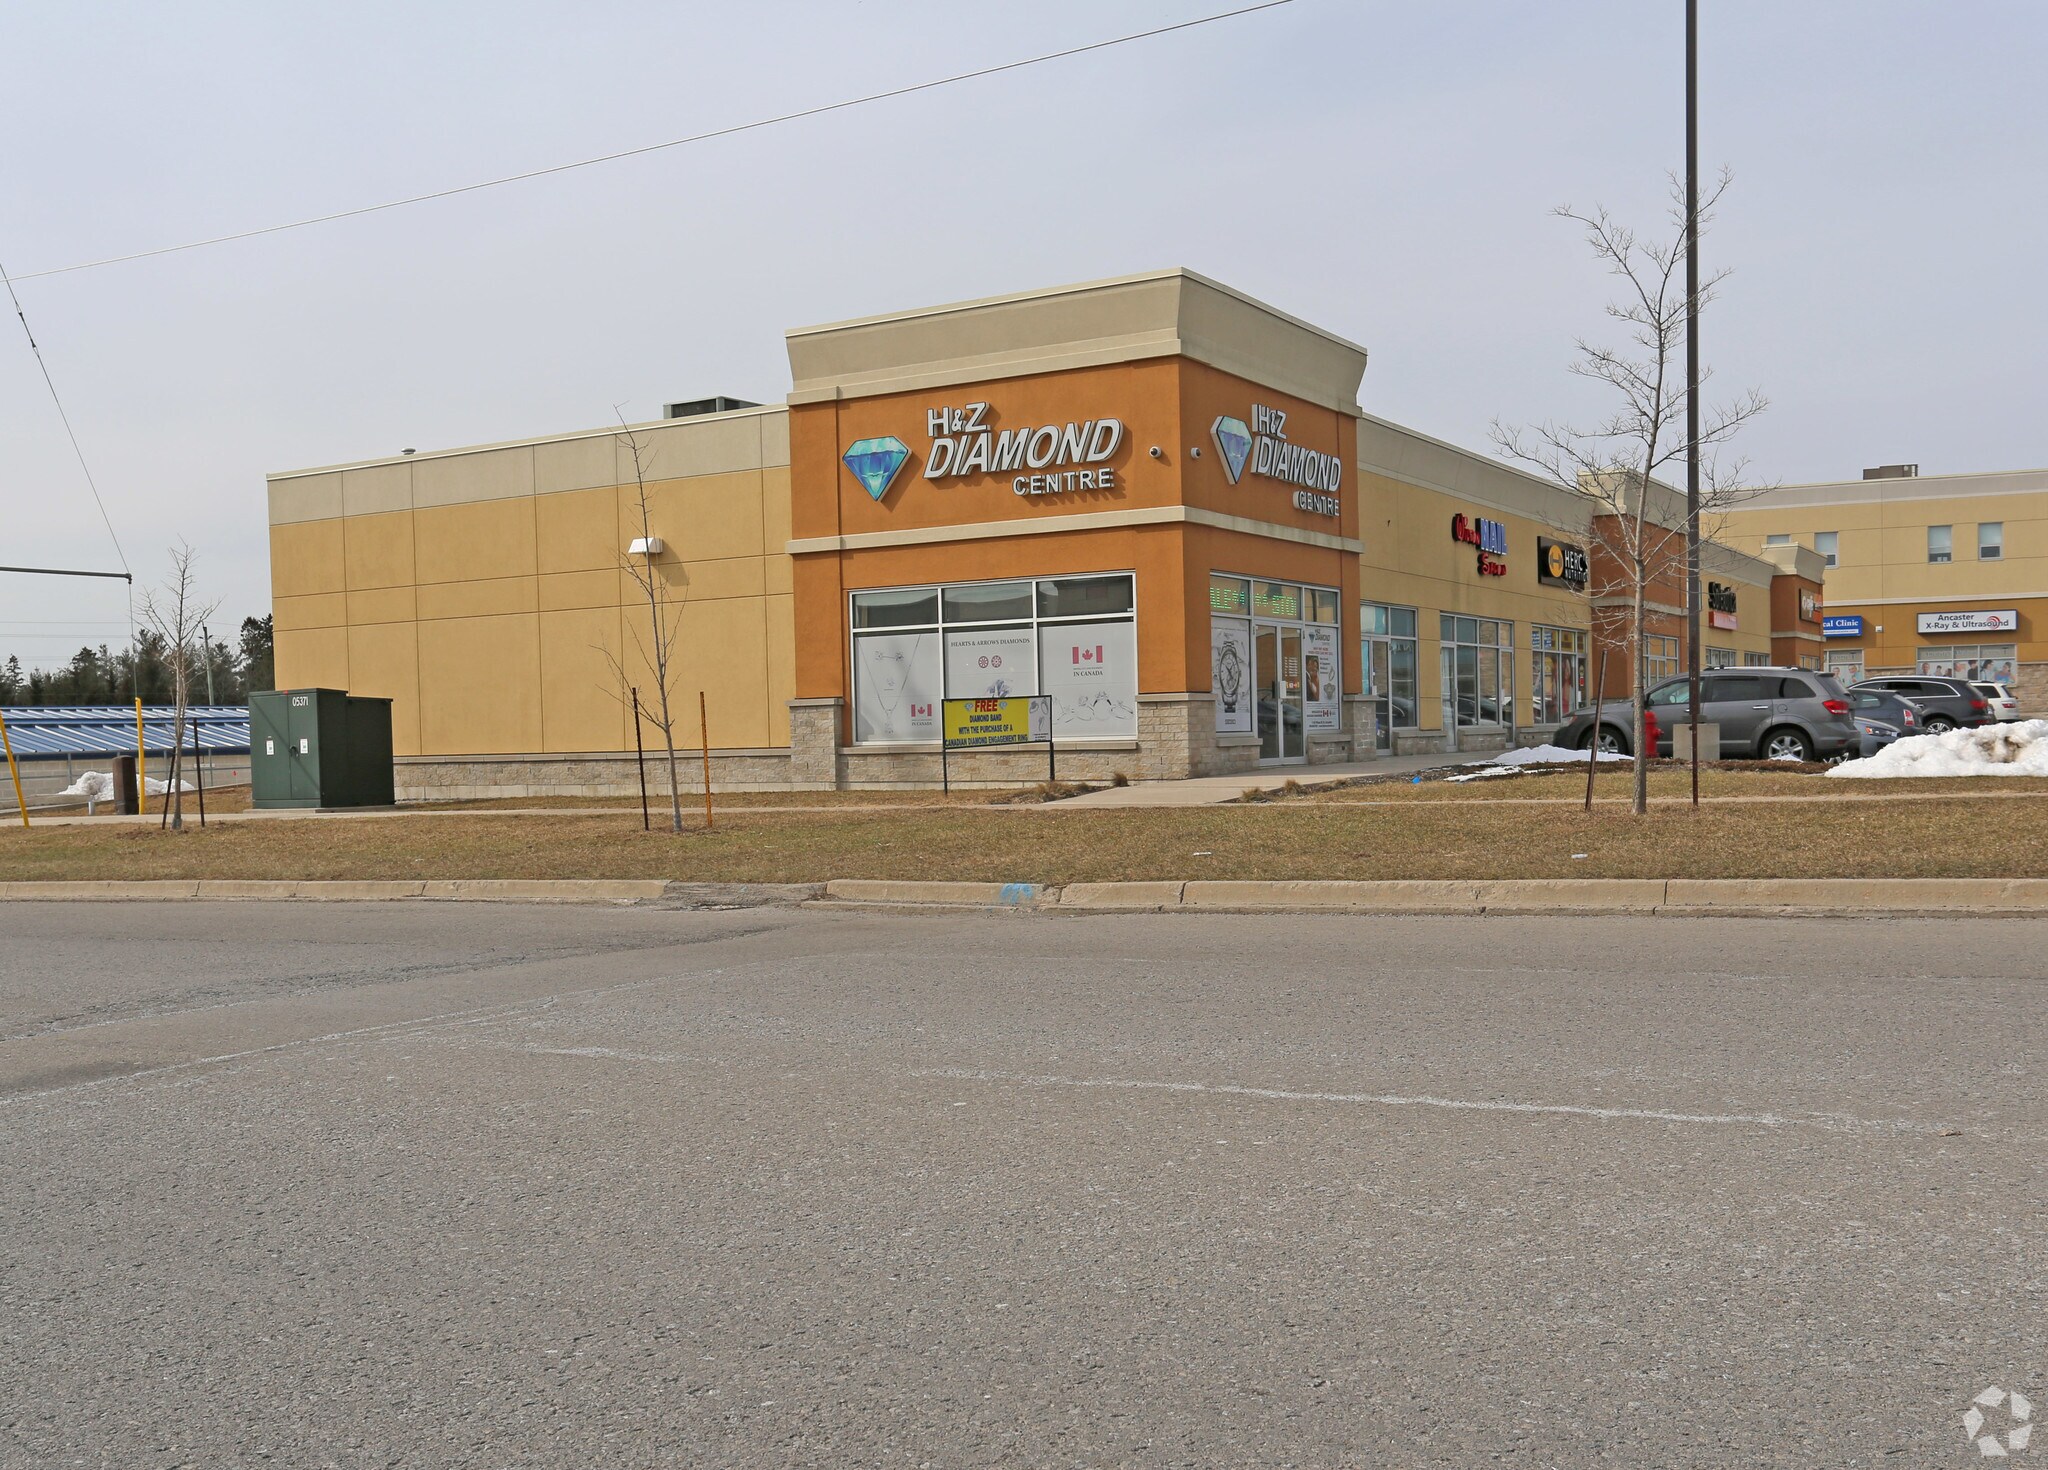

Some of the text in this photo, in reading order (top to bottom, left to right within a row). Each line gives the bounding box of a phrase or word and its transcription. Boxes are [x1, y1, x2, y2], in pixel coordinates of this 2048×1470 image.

[927, 401, 991, 437] H&Z
[1254, 403, 1288, 439] H&Z
[923, 417, 1125, 479] DIAMOND
[1253, 435, 1342, 492] DIAMOND
[1012, 468, 1115, 496] CENTRE
[1295, 491, 1340, 517] CENTRE
[1477, 517, 1507, 556] NAIL
[1835, 618, 1859, 628] Clinic
[1925, 619, 2009, 630] X-Ray & Ultrasound
[1938, 614, 1975, 622] Ancaster
[292, 696, 309, 707] 05371
[974, 699, 998, 713] FREE
[969, 713, 1002, 723] DIAMOND BAND
[958, 724, 1013, 735] WITH THE PURCHASE OF A
[945, 738, 968, 747] CANADIAN
[968, 737, 988, 746] DIAMOND
[988, 735, 1017, 744] ENGAGEMENT
[1017, 734, 1029, 743] RING
